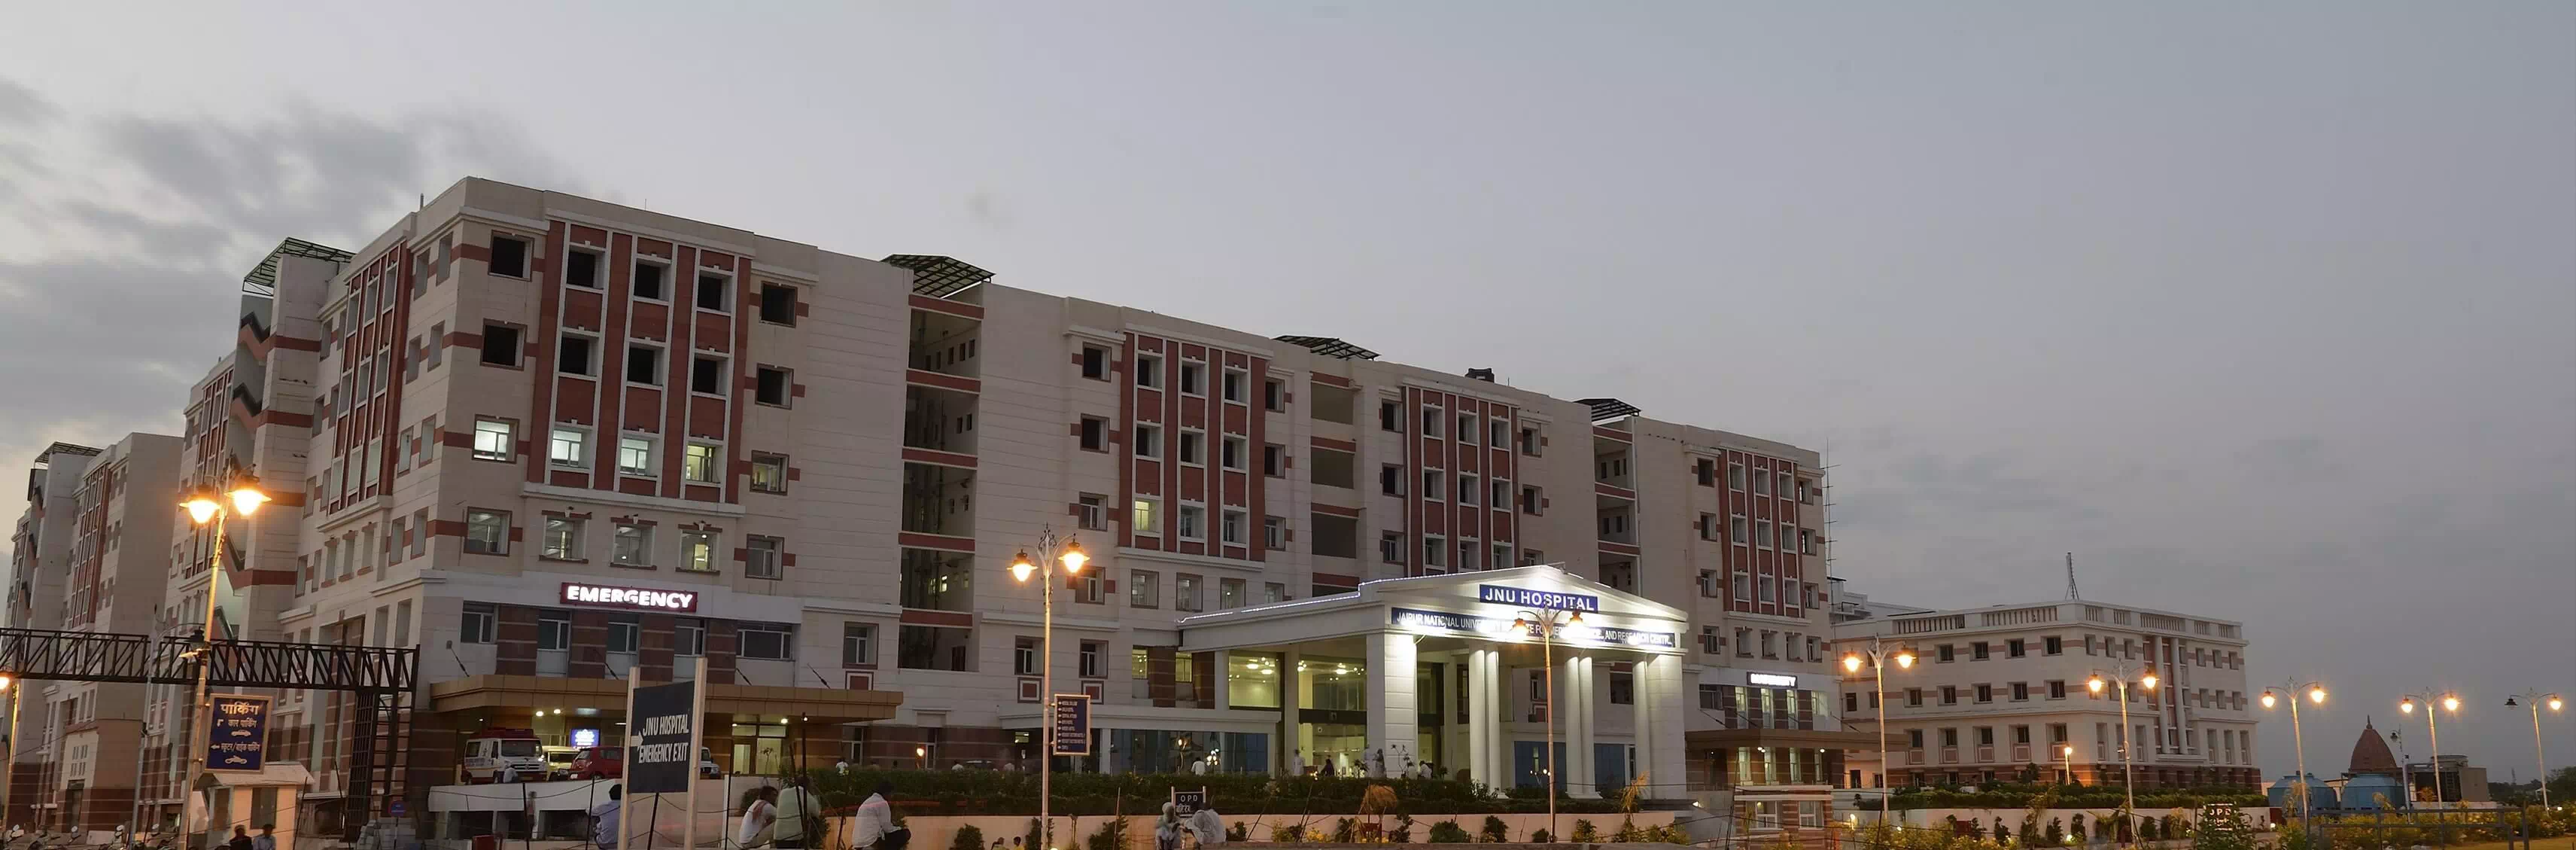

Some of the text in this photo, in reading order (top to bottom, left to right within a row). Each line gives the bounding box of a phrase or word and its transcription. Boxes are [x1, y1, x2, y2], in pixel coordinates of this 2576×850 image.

[567, 585, 693, 608] EMERGENCY
[1485, 588, 1595, 611] JNU HOSPITAL
[1397, 611, 1423, 626] JAIPUR
[1605, 629, 1617, 640] AND
[220, 701, 260, 715] पार्किंग
[643, 714, 689, 736] JNU HOSPITAL
[638, 742, 689, 763] EMERGENCY EXIT
